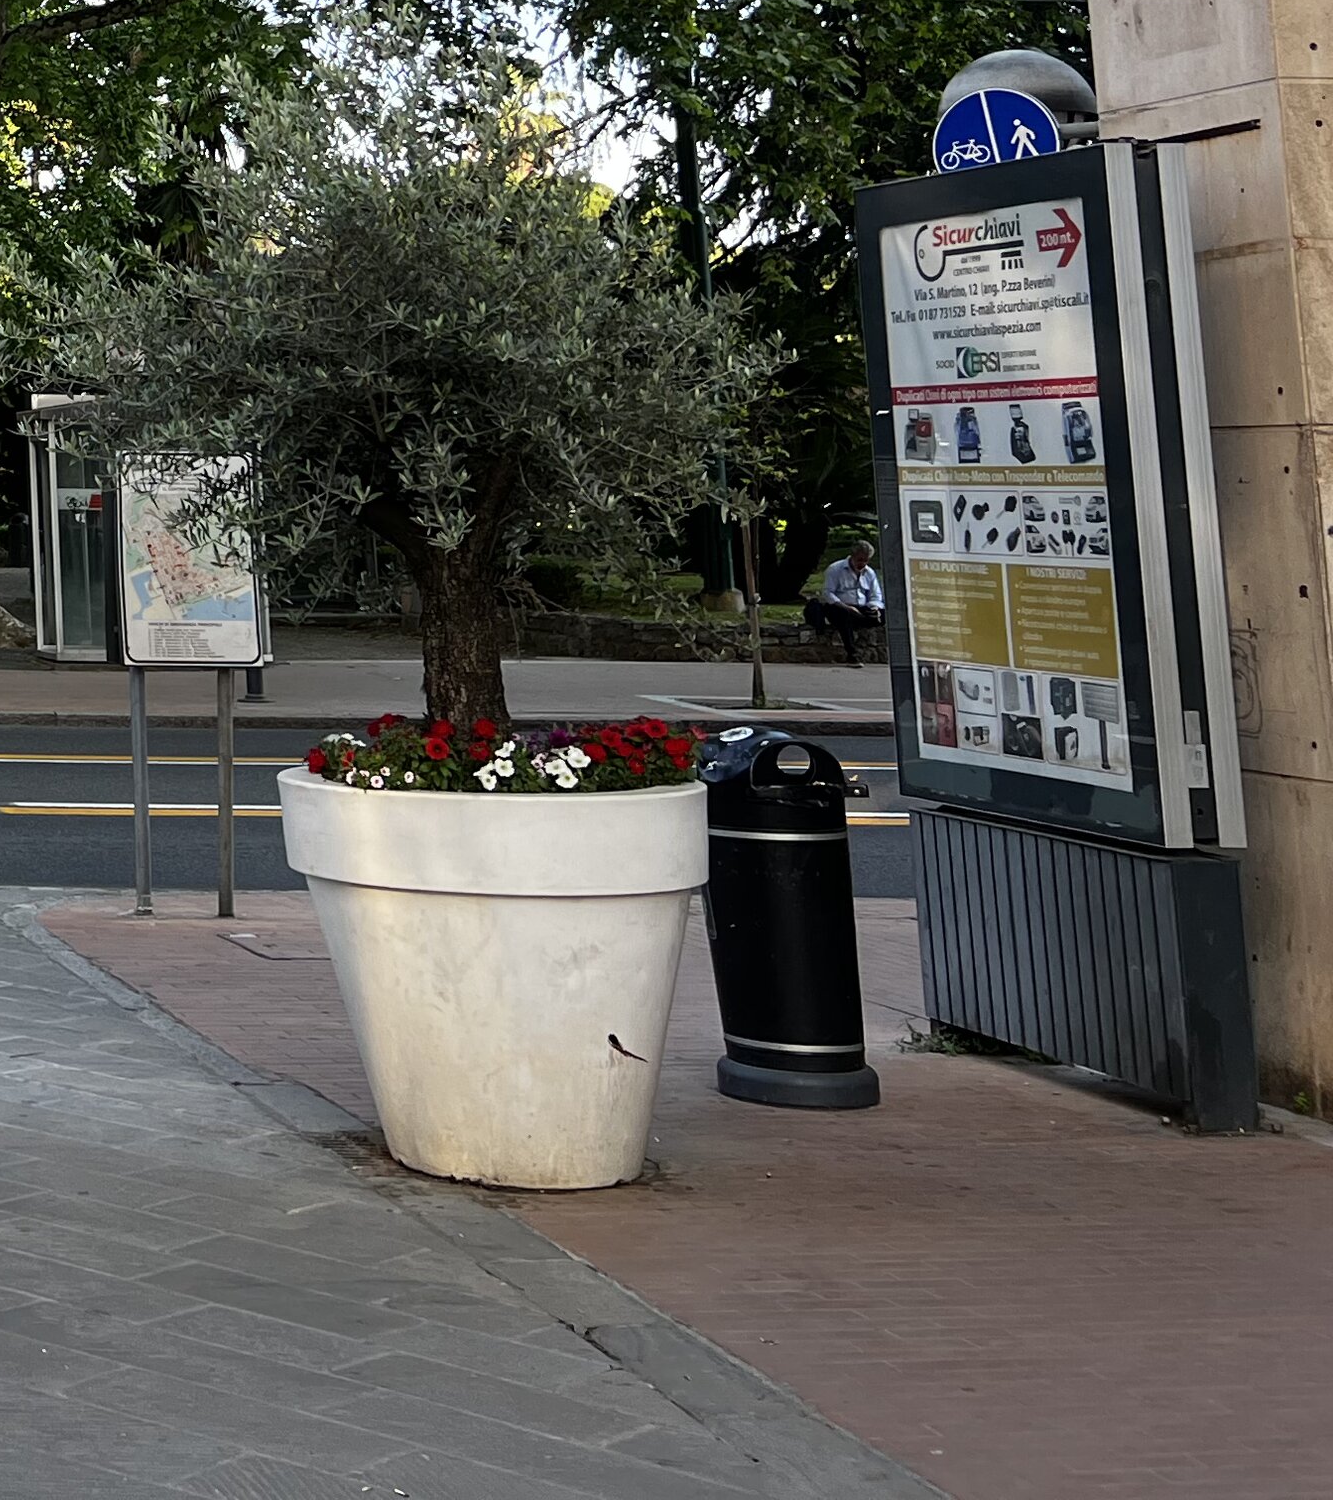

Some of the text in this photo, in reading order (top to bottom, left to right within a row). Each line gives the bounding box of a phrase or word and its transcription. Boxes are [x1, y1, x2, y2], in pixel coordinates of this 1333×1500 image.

[932, 214, 1021, 247] Sicurchiavi
[914, 288, 928, 301] Via
[928, 288, 936, 299] S.
[937, 286, 967, 300] Martino,
[968, 283, 978, 296] 12
[981, 282, 1000, 297] (ang.
[1001, 280, 1022, 292] P.zza
[918, 308, 938, 321] 0187
[939, 305, 966, 319] 731529
[901, 470, 933, 484] Duplicati
[1046, 473, 1052, 482] e
[1052, 469, 1104, 482] Telecomando
